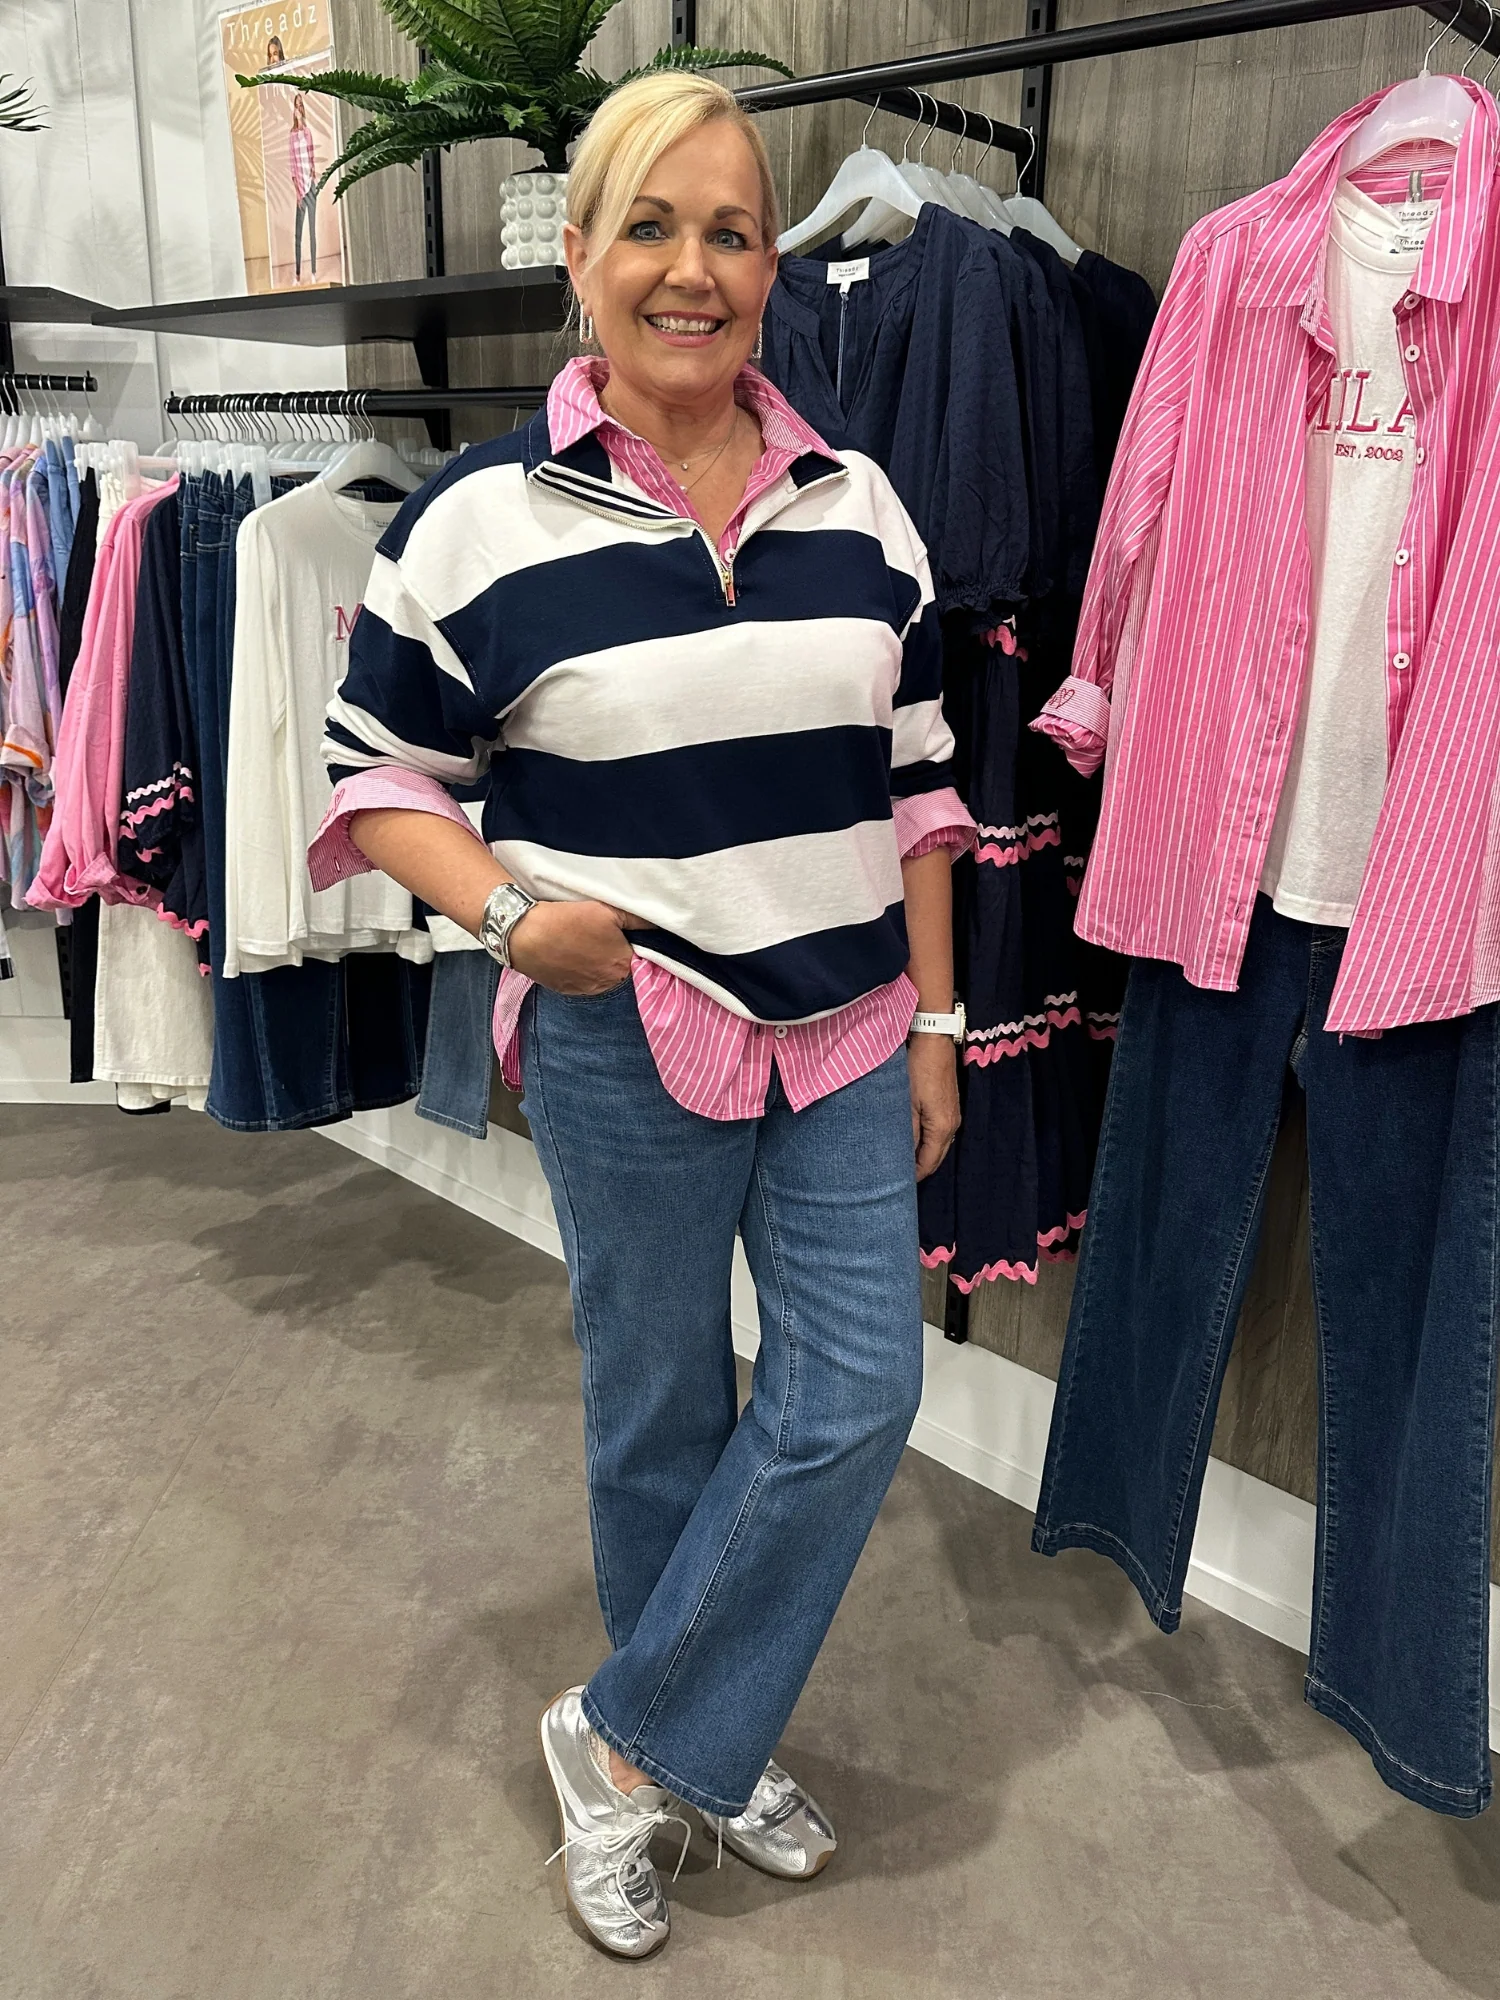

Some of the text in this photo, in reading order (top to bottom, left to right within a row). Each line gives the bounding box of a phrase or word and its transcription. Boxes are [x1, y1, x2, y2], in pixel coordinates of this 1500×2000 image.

[226, 3, 317, 46] Threadz
[1398, 209, 1434, 217] Threadz
[1365, 446, 1404, 462] 2002
